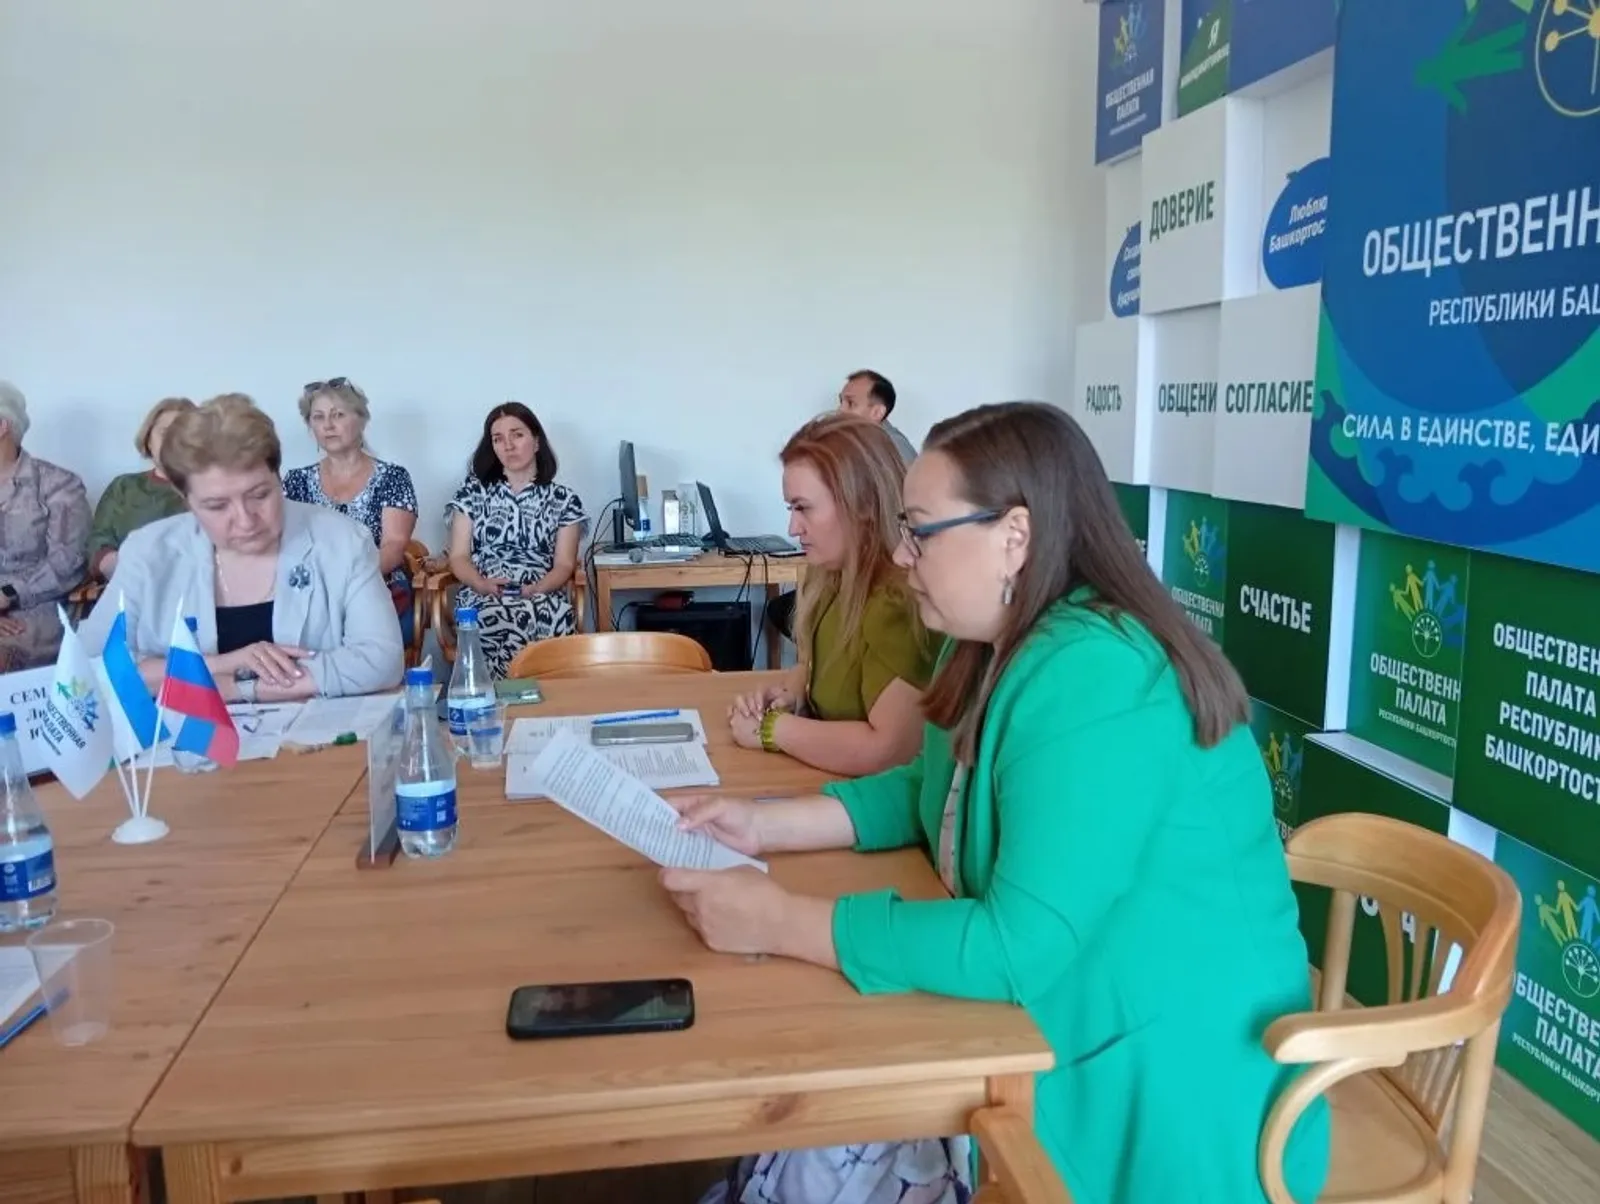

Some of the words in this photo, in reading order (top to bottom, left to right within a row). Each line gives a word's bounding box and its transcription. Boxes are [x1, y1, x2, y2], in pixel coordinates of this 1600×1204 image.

[1150, 181, 1215, 243] ДОВЕРИЕ
[1288, 195, 1328, 226] Люблю
[1363, 187, 1600, 278] ОБЩЕСТВЕНН
[1429, 288, 1556, 327] РЕСПУБЛИКИ
[1086, 384, 1122, 415] РАДОСТЬ
[1158, 381, 1218, 416] ОБЩЕНИ
[1225, 380, 1314, 414] СОГЛАСИЕ
[1342, 413, 1394, 441] СИЛА
[1400, 416, 1412, 441] В
[1417, 416, 1536, 453] ЕДИНСТВЕ,
[1544, 421, 1600, 458] ЕДИ
[1239, 584, 1313, 634] СЧАСТЬЕ
[1493, 622, 1600, 677] ОБЩЕСТВЕН
[1395, 686, 1447, 726] ПАЛАТА
[1525, 670, 1597, 718] ПАЛАТА
[1513, 970, 1600, 1047] БЩЕСТВЕ
